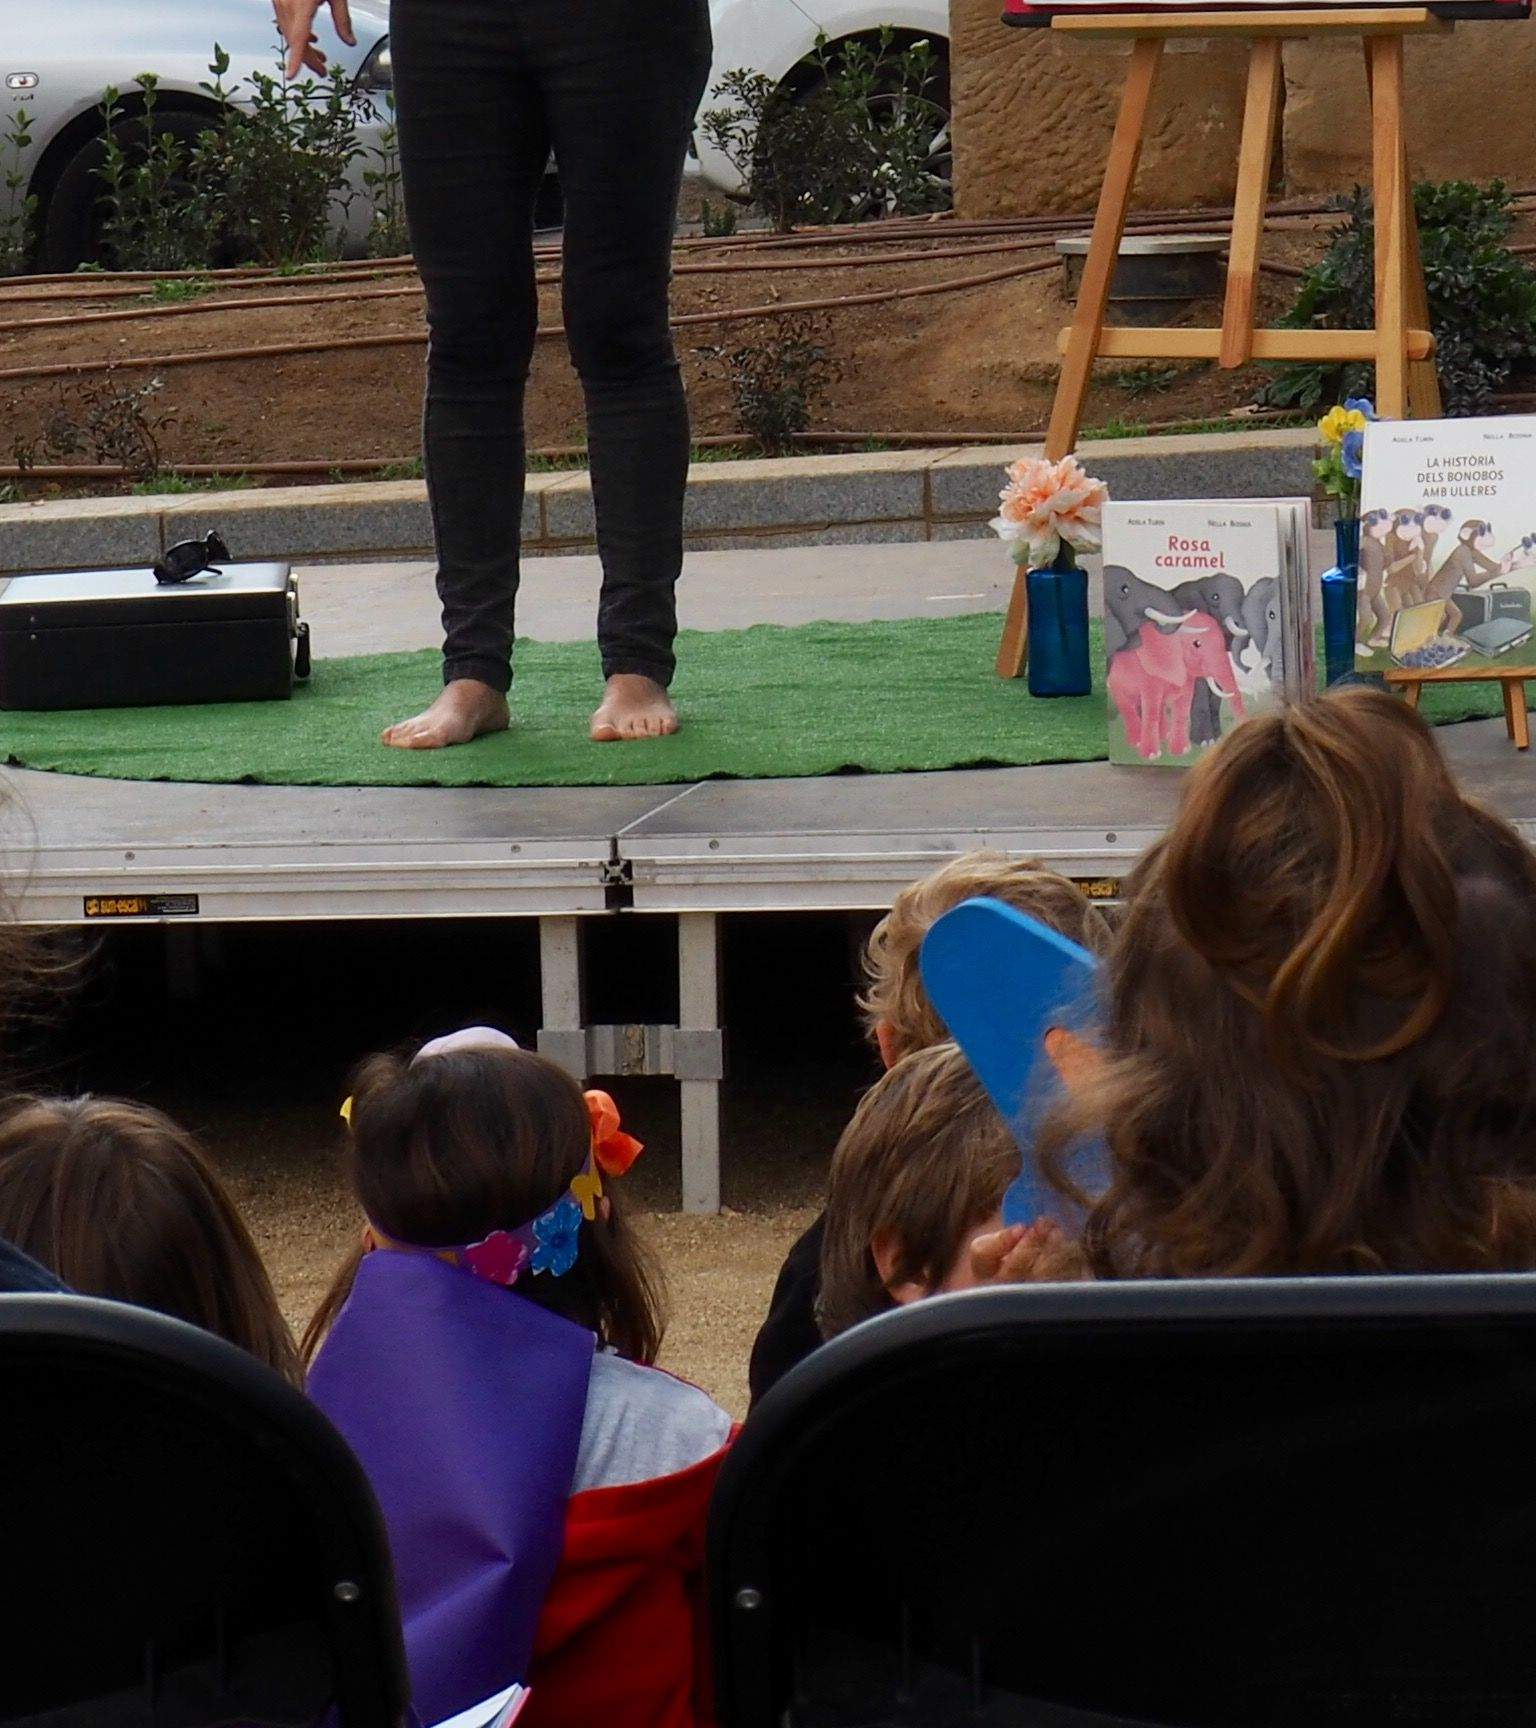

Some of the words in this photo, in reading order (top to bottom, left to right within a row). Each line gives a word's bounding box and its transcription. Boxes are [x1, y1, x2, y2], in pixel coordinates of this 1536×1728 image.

[1426, 457, 1439, 468] LA
[1417, 472, 1444, 483] DELS
[1447, 470, 1504, 482] BONOBOS
[1422, 486, 1447, 497] AMB
[1450, 485, 1497, 497] ULLERES
[1168, 535, 1210, 552] Rosa
[1155, 552, 1225, 569] caramel
